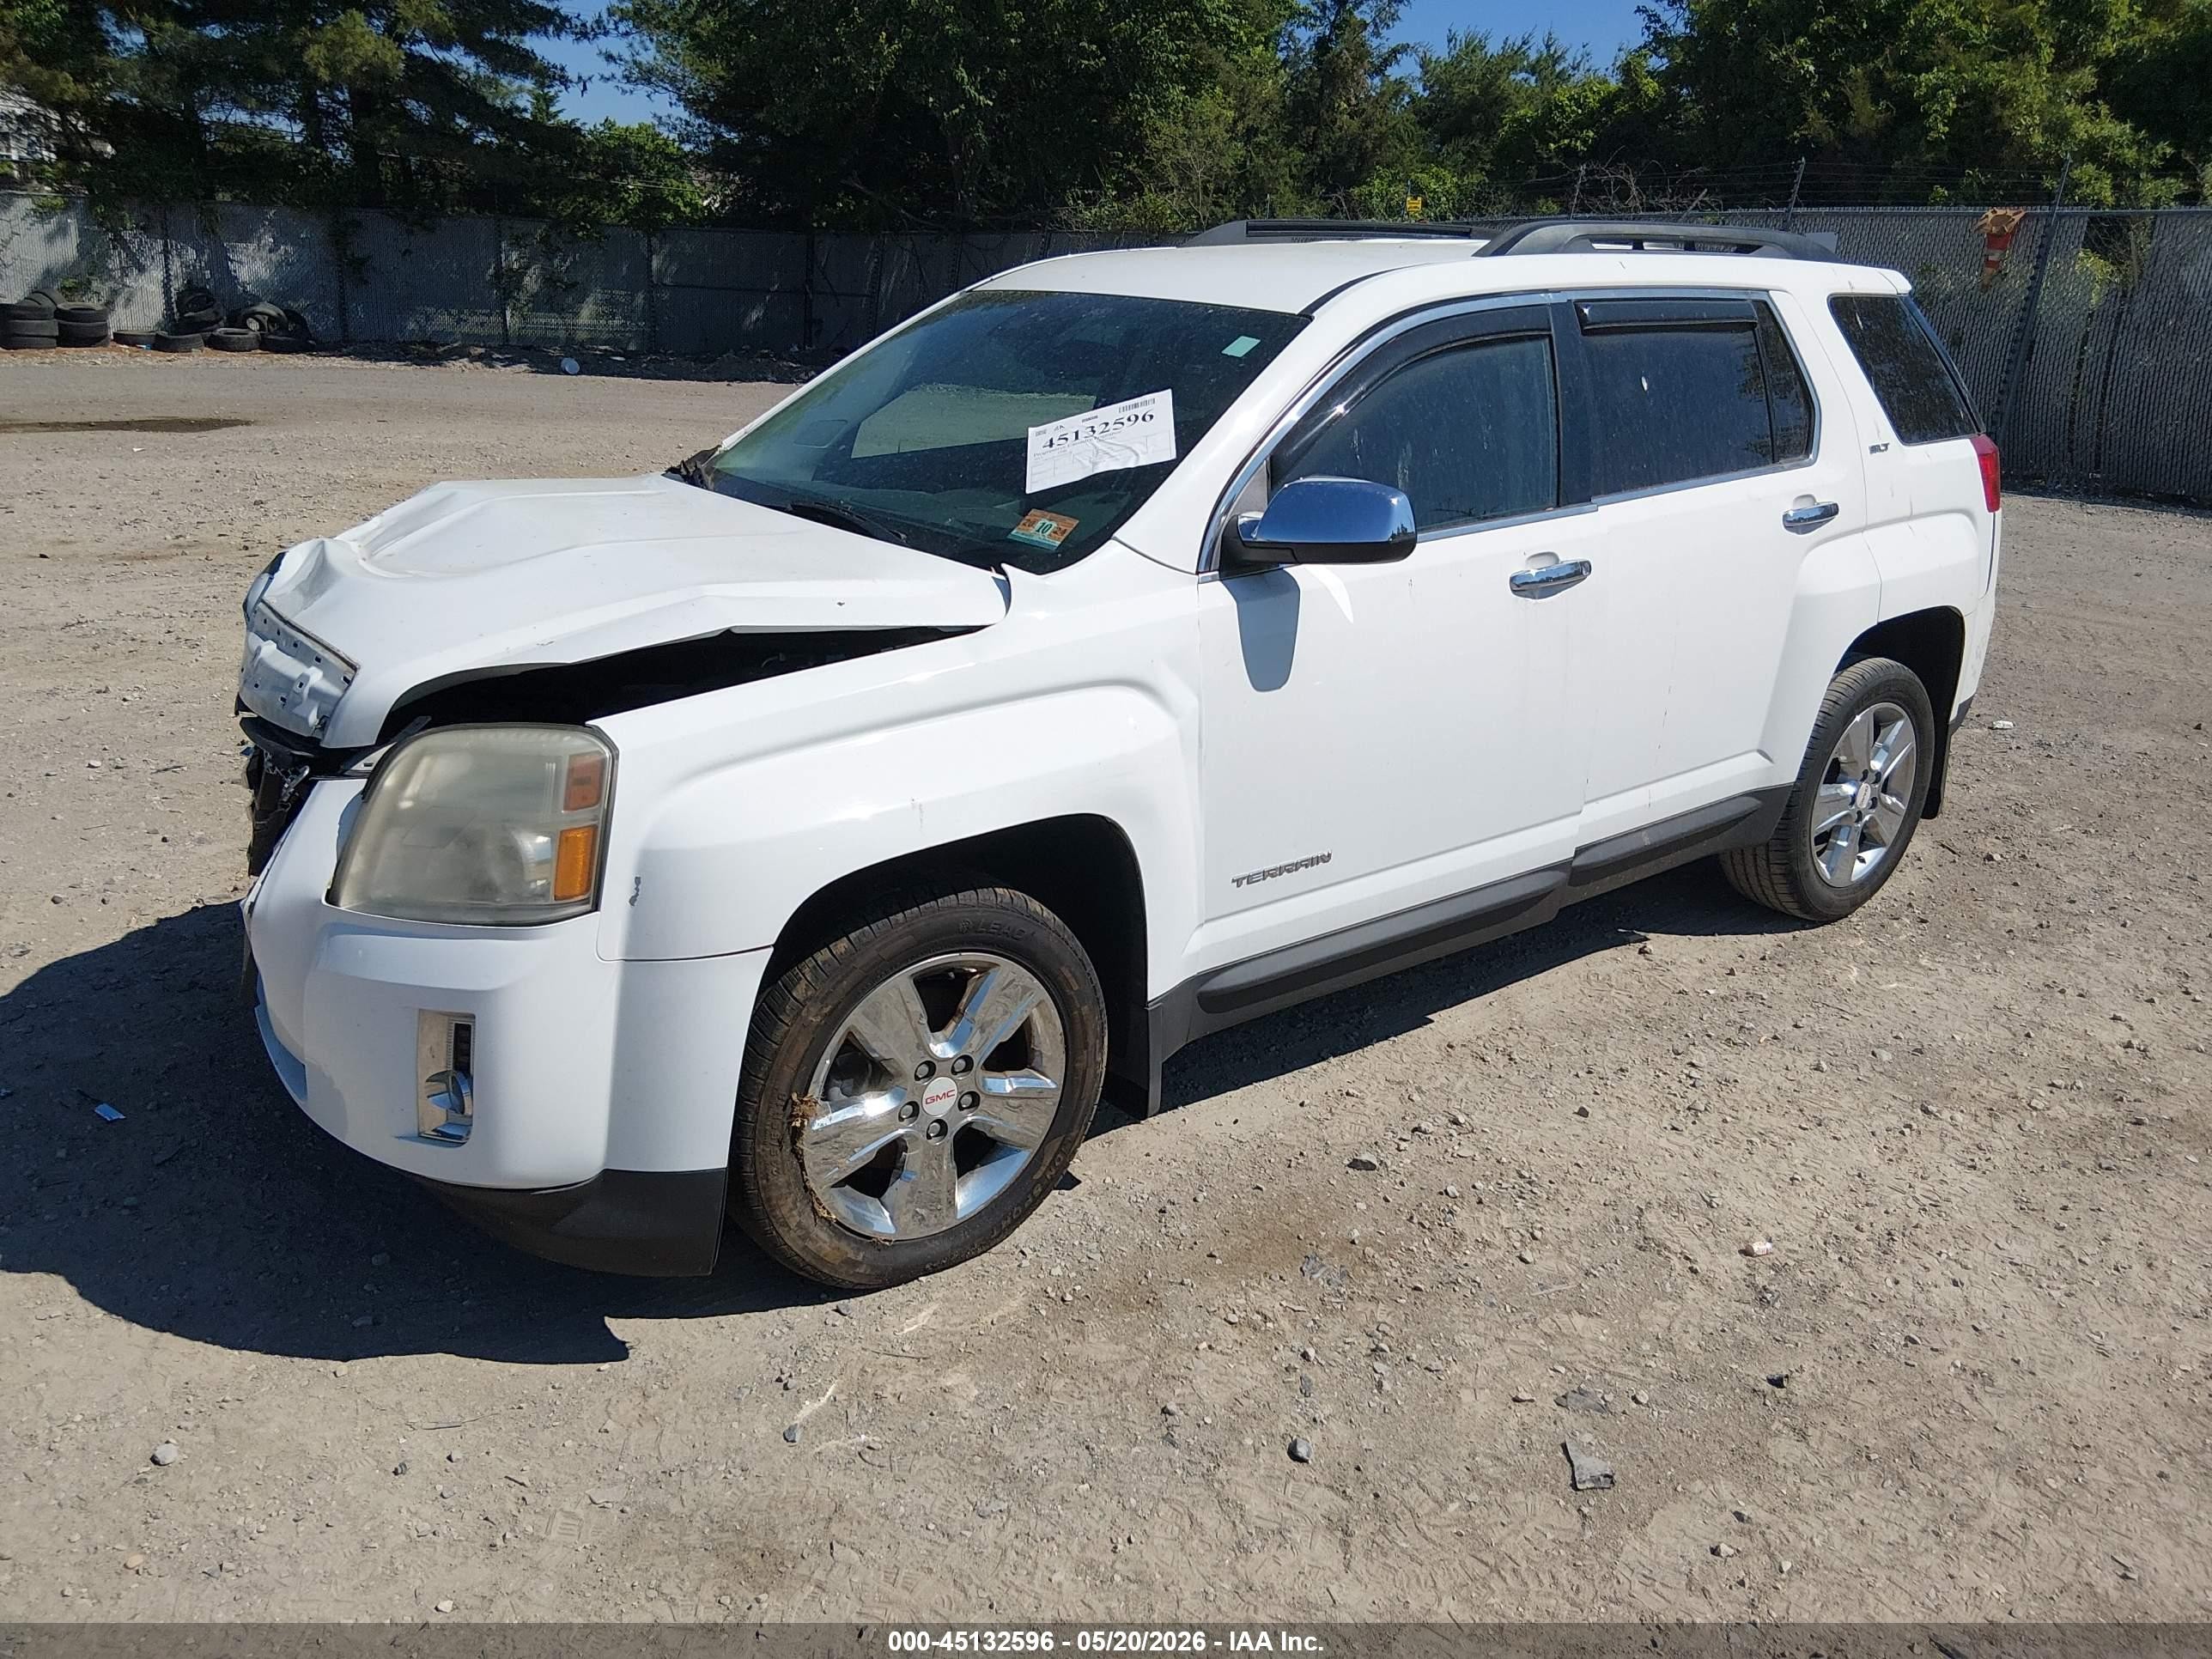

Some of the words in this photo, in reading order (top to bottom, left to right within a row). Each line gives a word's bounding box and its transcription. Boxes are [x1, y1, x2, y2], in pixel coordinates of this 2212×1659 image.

[1042, 410, 1155, 449] 45132596
[1036, 521, 1052, 534] 10
[1231, 851, 1333, 888] TERRAIN
[925, 1089, 955, 1105] GMC
